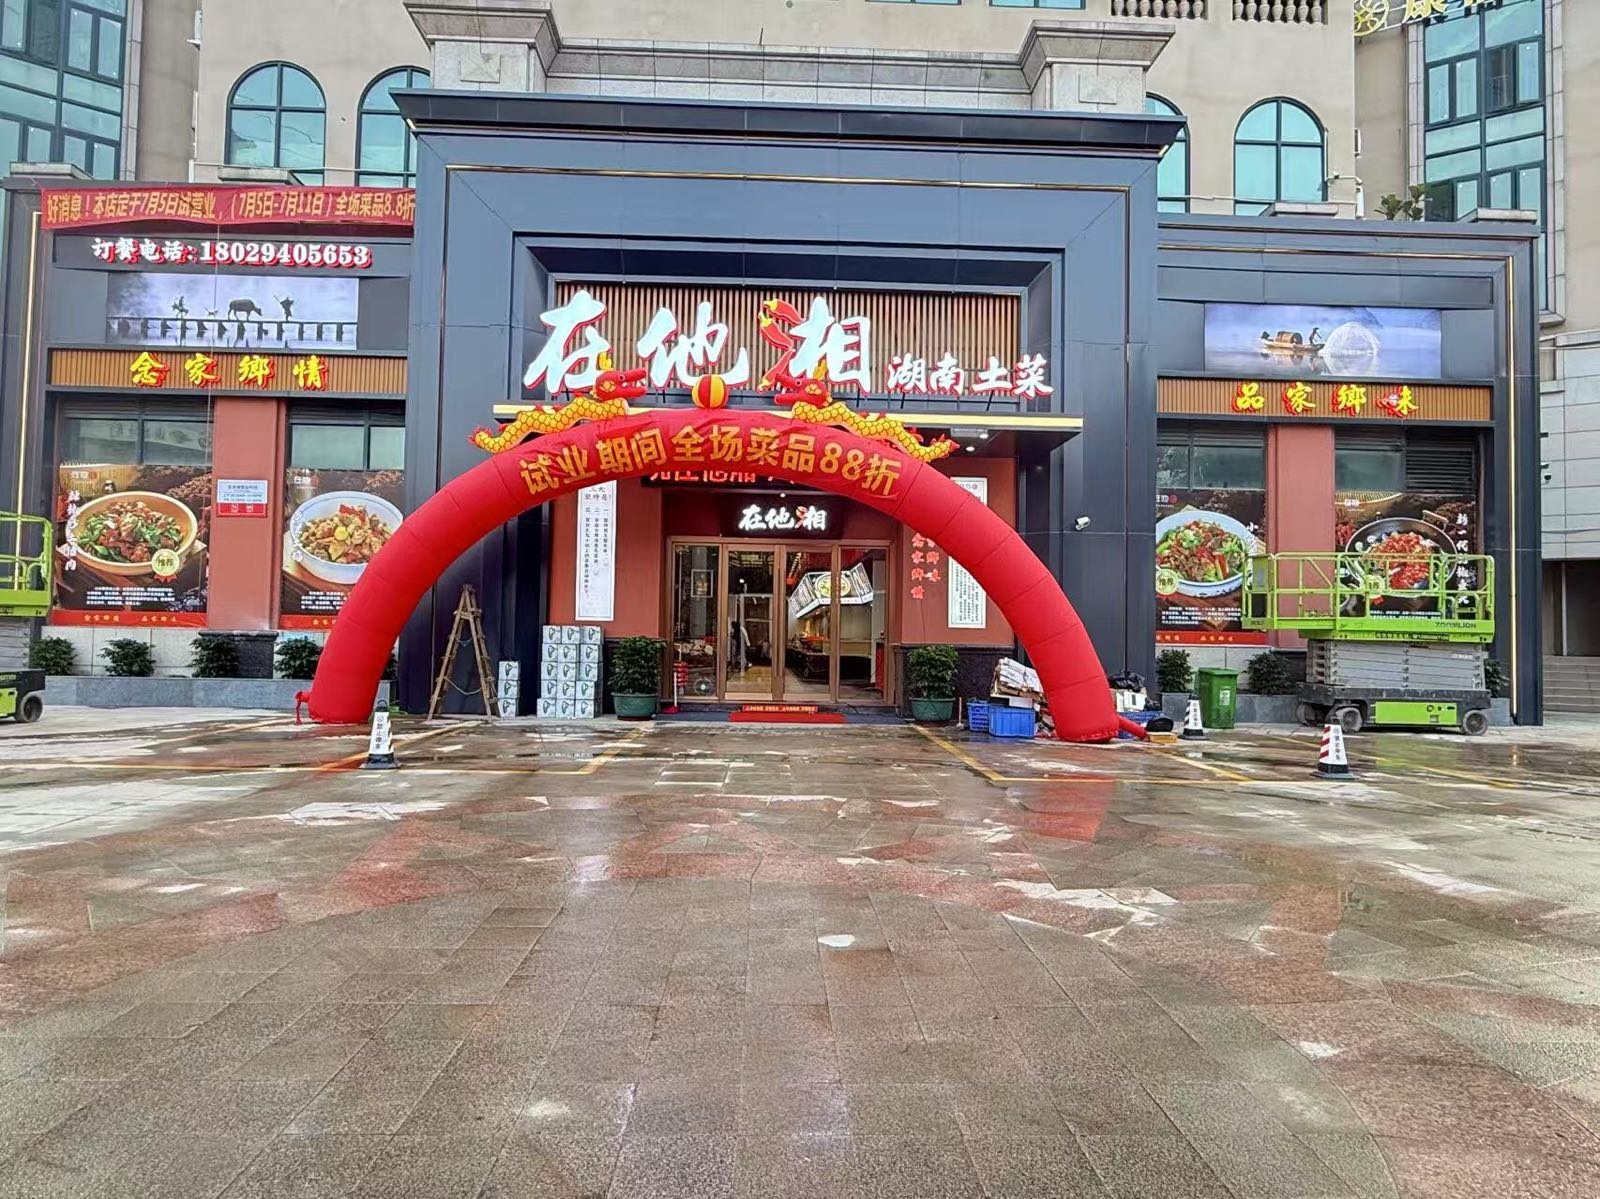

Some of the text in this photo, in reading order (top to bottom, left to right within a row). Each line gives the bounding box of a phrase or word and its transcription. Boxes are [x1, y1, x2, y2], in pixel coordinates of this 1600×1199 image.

[523, 290, 873, 395] 在他湘
[130, 352, 328, 391] 念家鄉情
[886, 351, 1054, 399] 湖南土菜
[519, 424, 901, 497] 试业期间全场菜品88折
[739, 504, 827, 530] 在他湘
